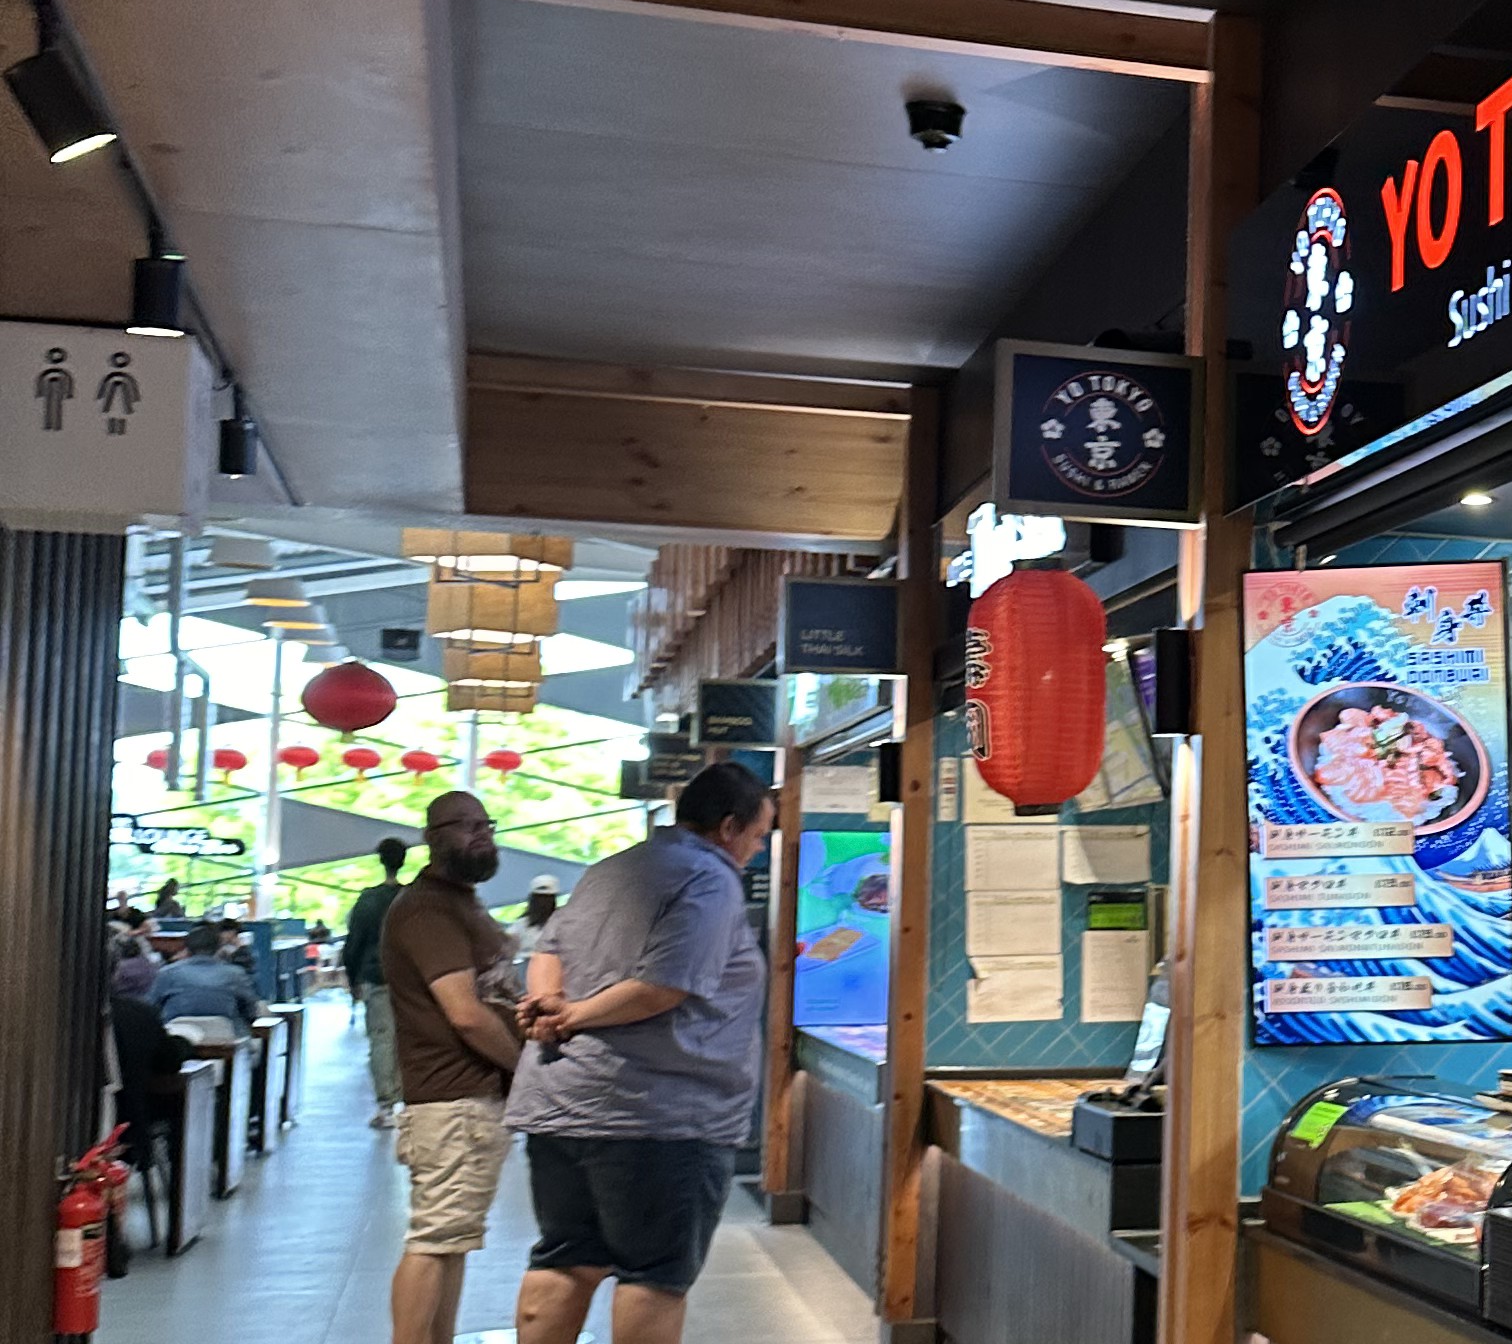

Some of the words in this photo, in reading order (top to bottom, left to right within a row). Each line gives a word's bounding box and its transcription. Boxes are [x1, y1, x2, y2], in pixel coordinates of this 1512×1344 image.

[1380, 130, 1463, 292] YO
[1447, 258, 1512, 348] Sushi
[1054, 381, 1085, 405] YO
[1087, 374, 1154, 414] TOKYO
